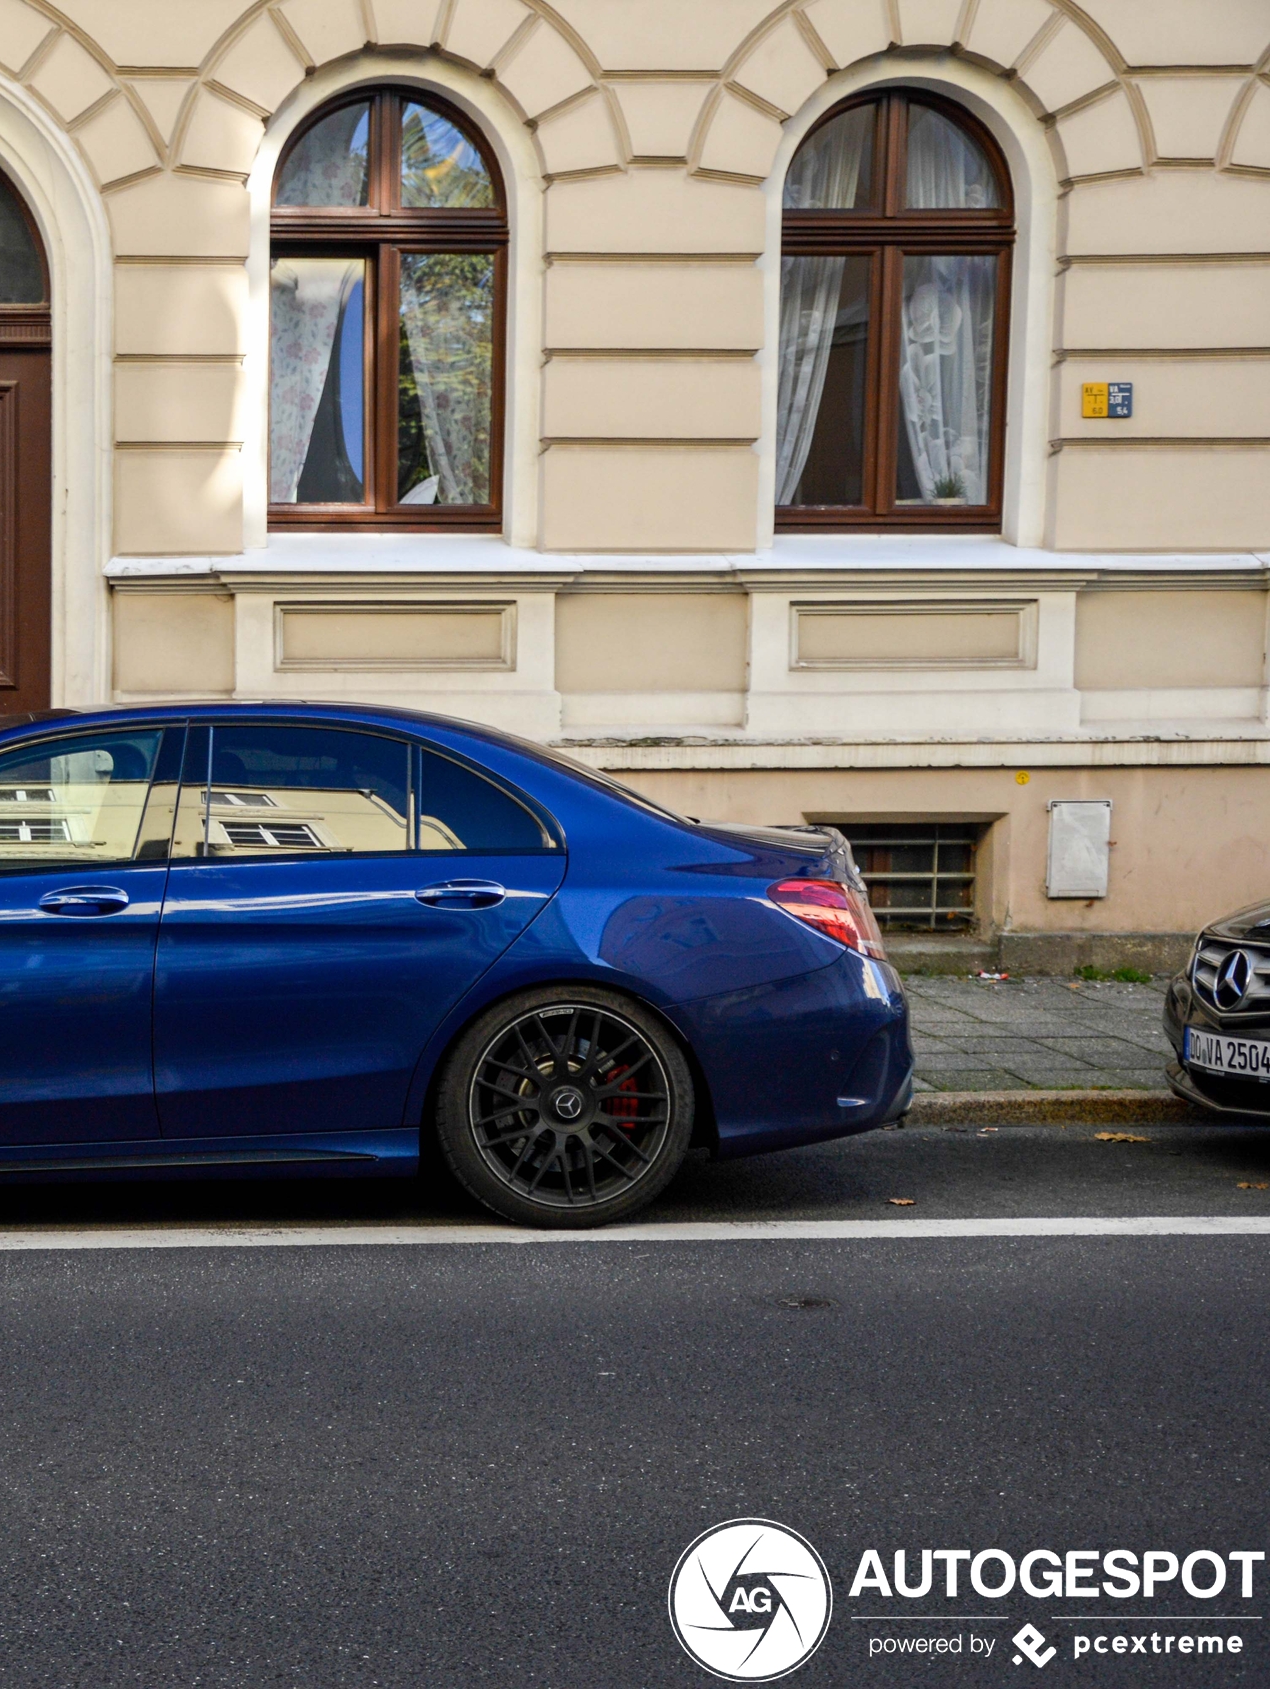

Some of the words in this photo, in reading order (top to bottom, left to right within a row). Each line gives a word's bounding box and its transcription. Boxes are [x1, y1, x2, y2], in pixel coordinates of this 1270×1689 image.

[1190, 1032, 1201, 1060] DO
[1206, 1037, 1223, 1067] VA
[1227, 1041, 1270, 1074] 2504
